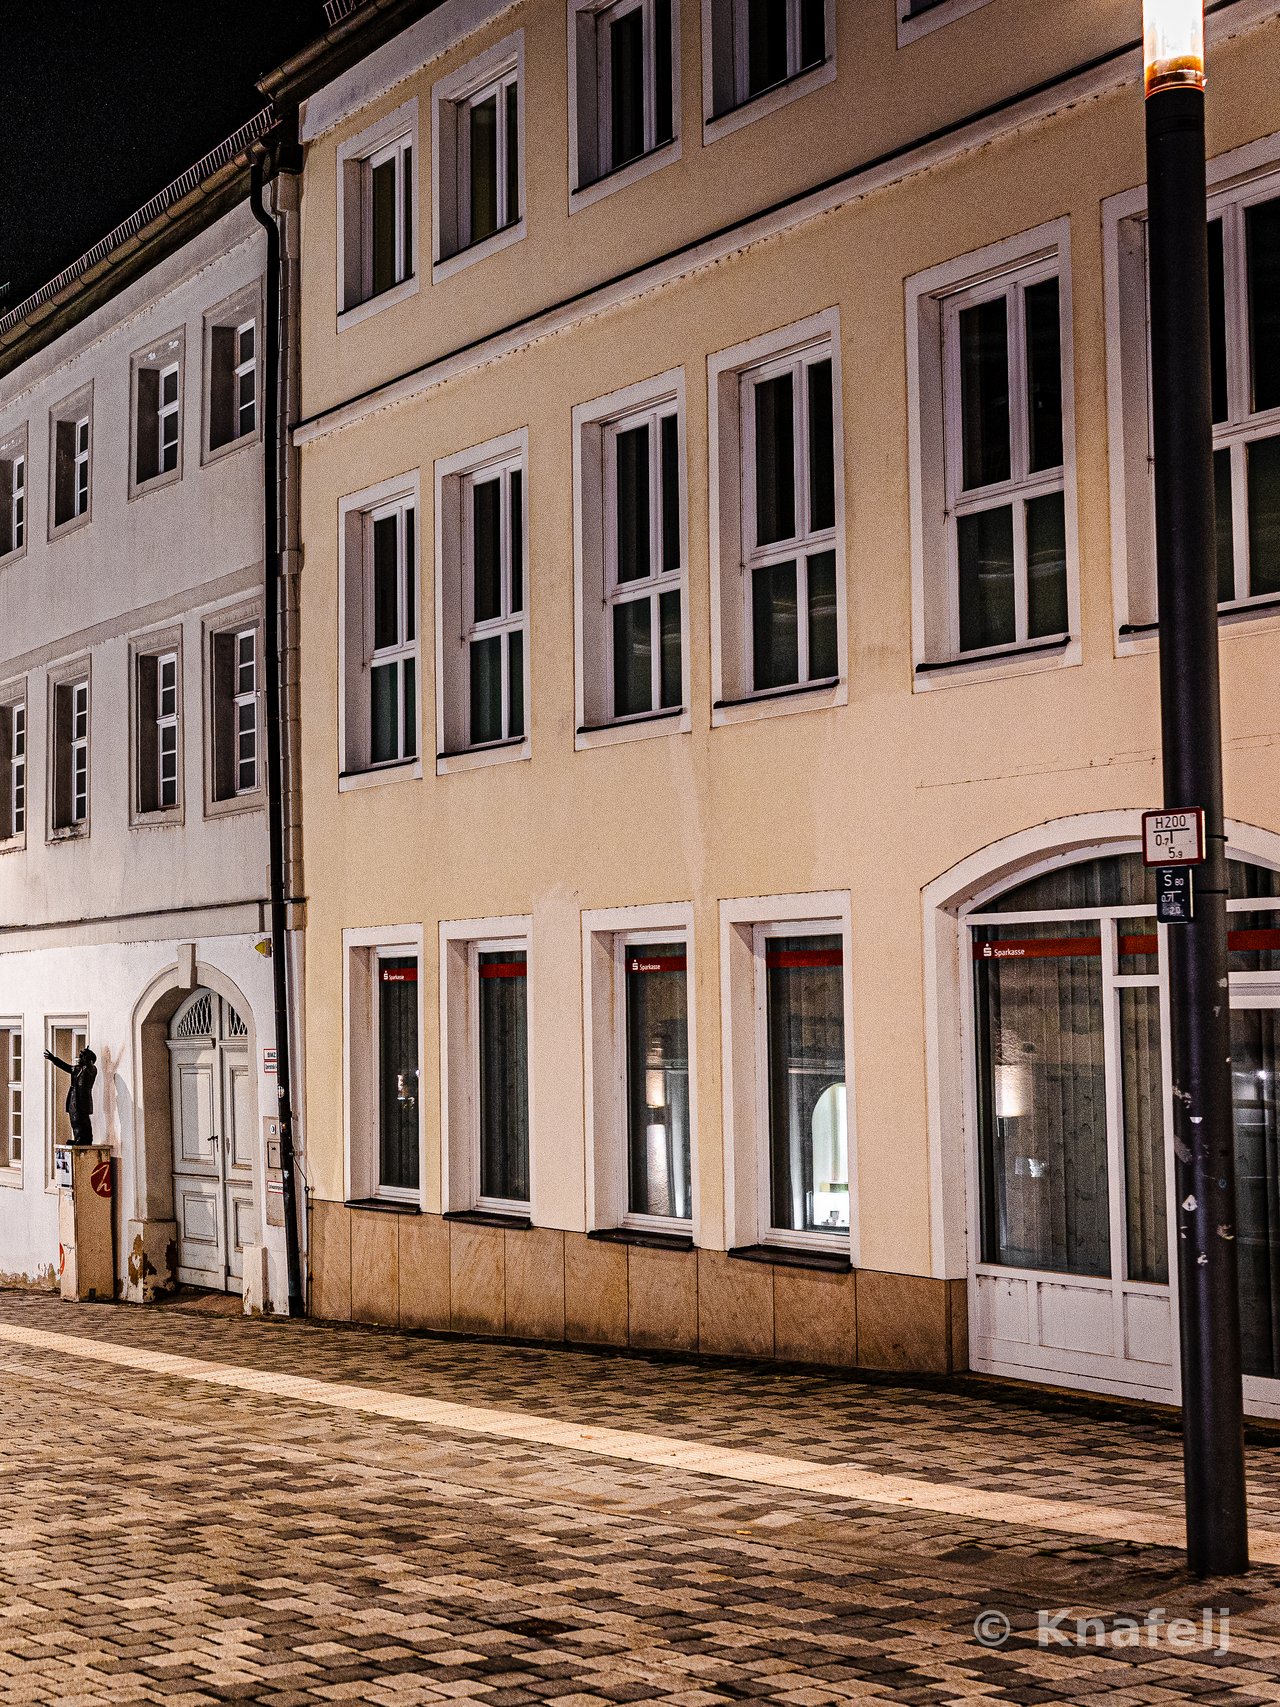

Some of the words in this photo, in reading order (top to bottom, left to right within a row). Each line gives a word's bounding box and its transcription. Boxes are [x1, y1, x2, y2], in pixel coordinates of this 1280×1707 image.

[1164, 874, 1172, 887] S
[993, 948, 1025, 957] Sparkasse
[639, 963, 661, 971] Sparkasse
